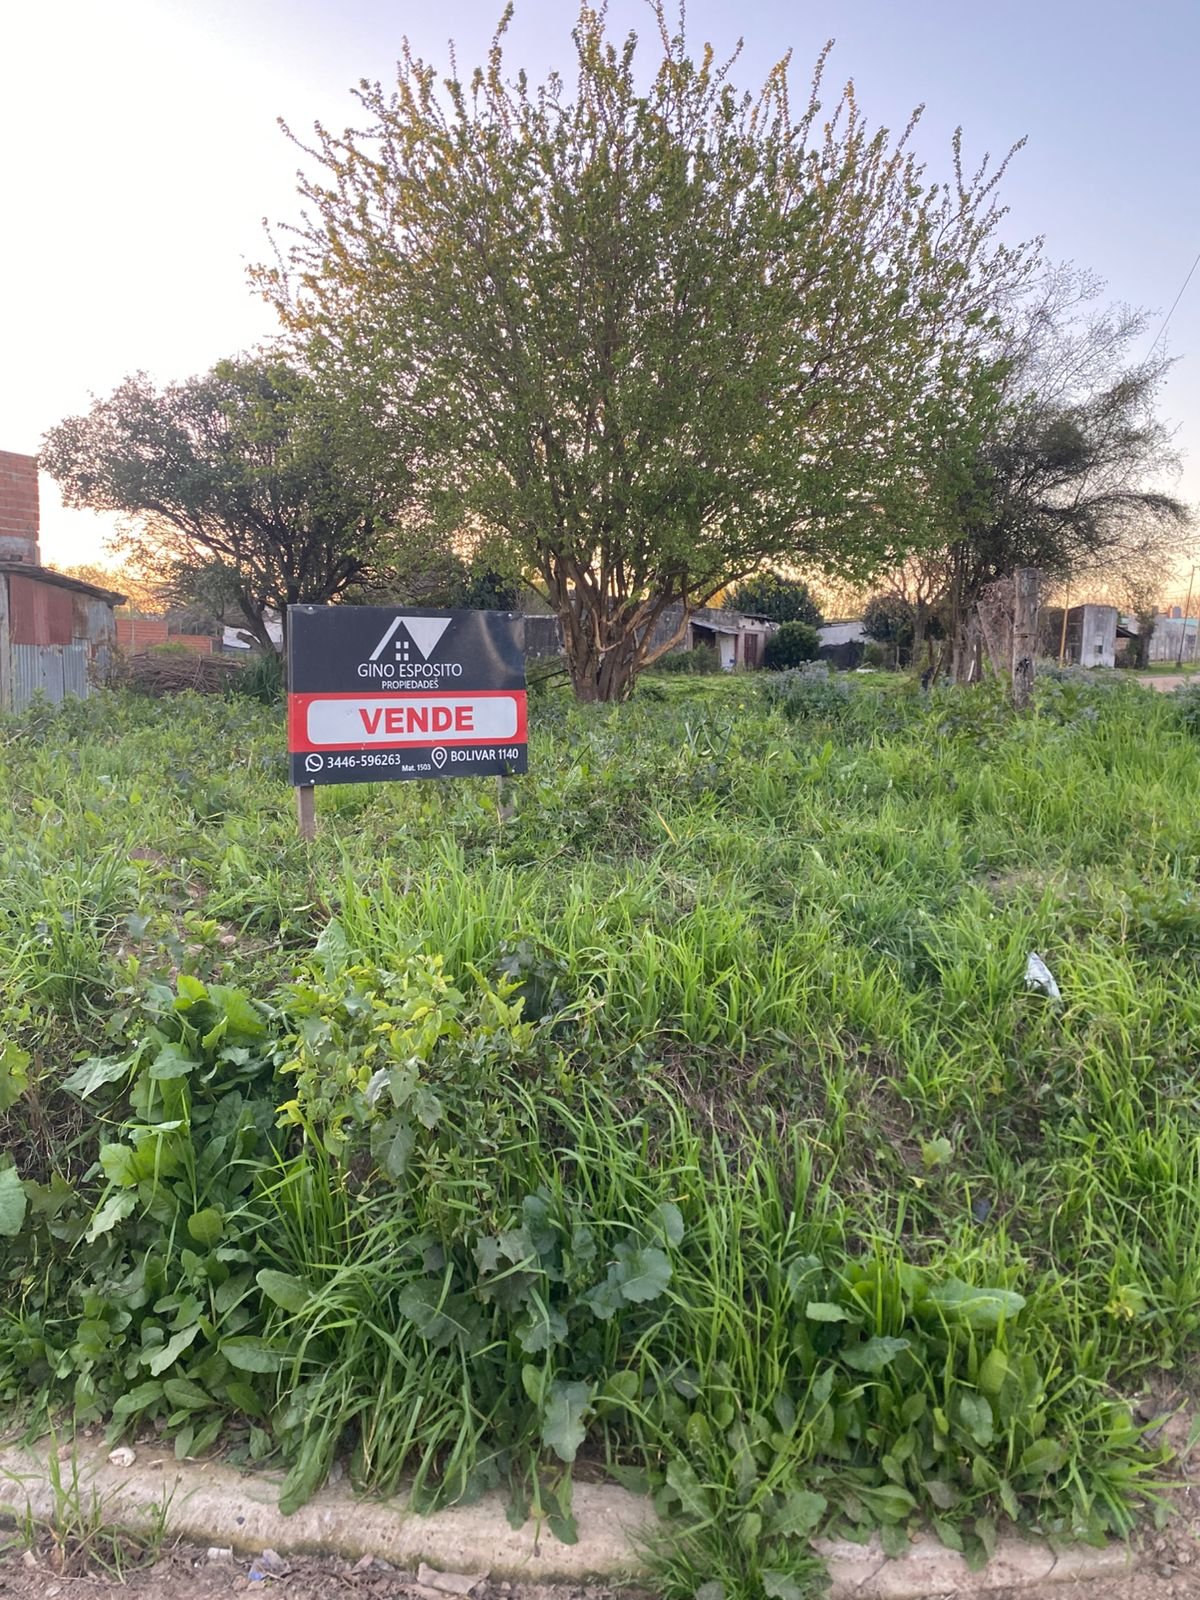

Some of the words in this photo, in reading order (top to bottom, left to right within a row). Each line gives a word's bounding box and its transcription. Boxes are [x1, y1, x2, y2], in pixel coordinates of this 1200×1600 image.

[357, 663, 395, 678] GINO
[399, 663, 463, 678] ESPOSITO
[381, 679, 439, 690] PROPIEDADES
[359, 706, 475, 735] VENDE
[327, 753, 401, 769] 3446-596263
[450, 749, 496, 762] BOLIVAR
[498, 748, 519, 760] 1140
[401, 764, 416, 772] Mat.
[417, 763, 432, 771] 1503
